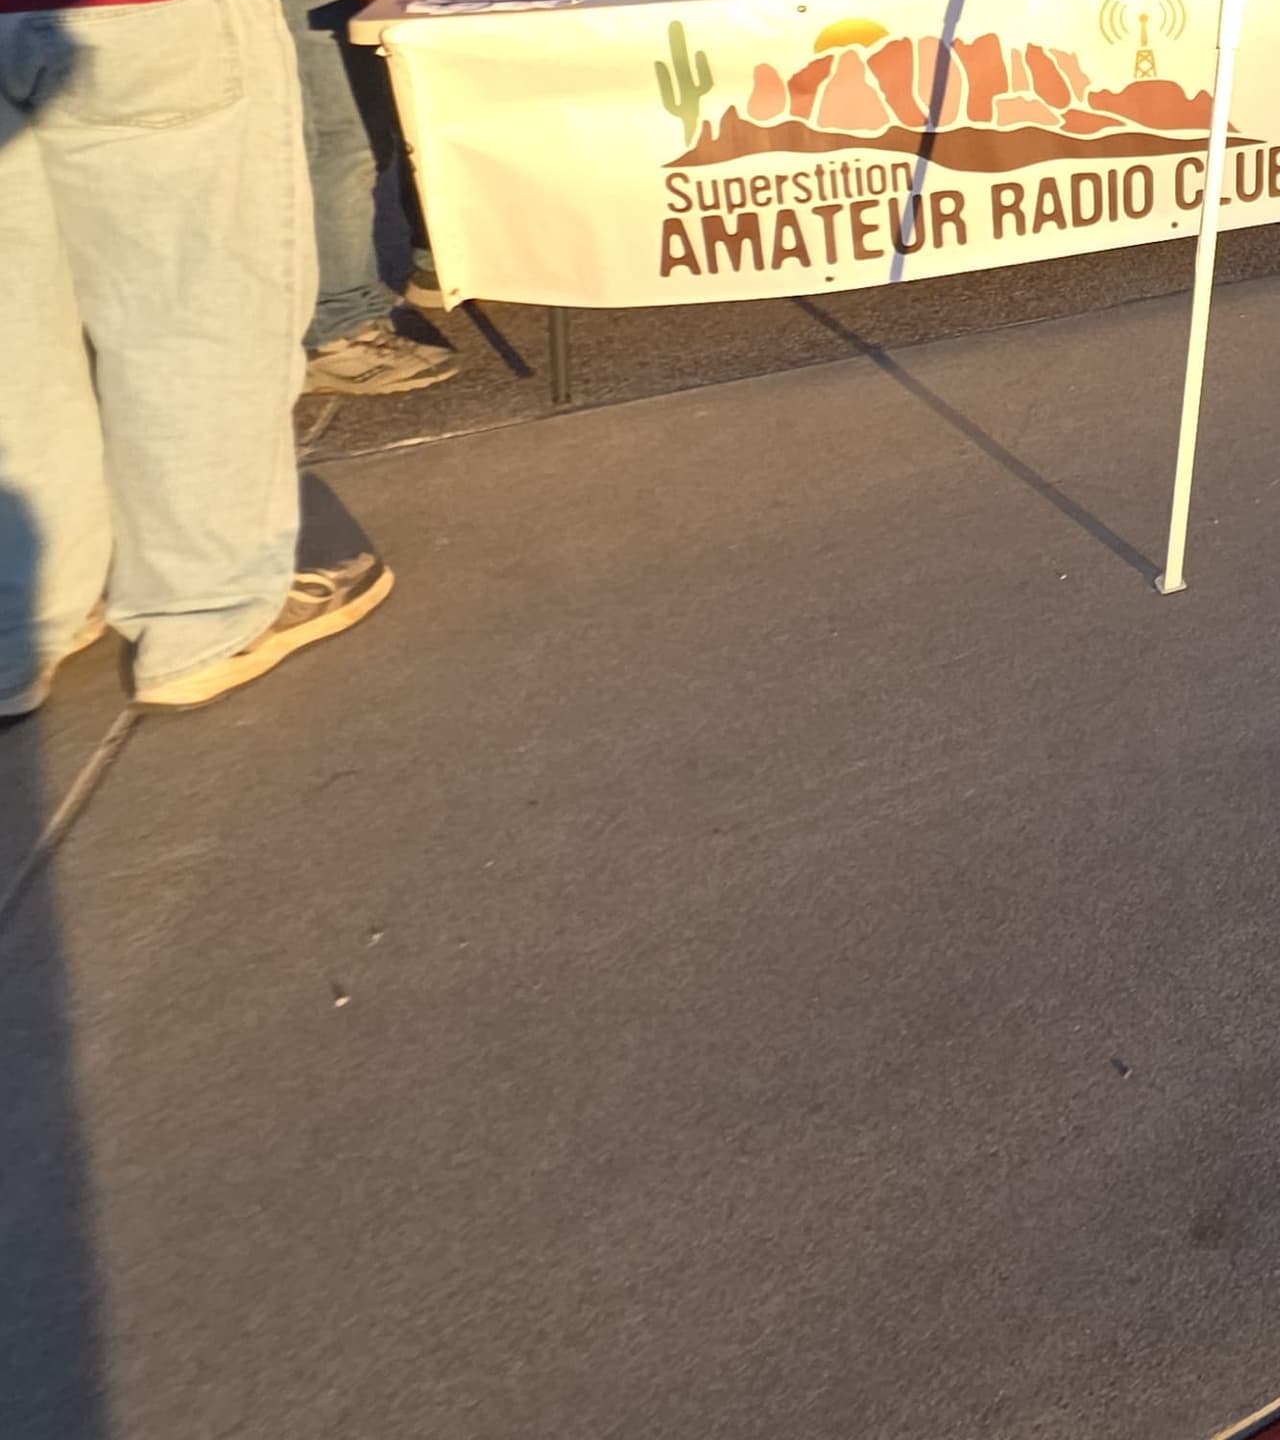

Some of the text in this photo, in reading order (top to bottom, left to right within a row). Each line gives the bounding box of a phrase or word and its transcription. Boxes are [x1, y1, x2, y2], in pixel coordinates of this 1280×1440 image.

[659, 190, 968, 278] AMATEUR
[990, 164, 1155, 240] RADIO
[664, 158, 914, 215] Superstition
